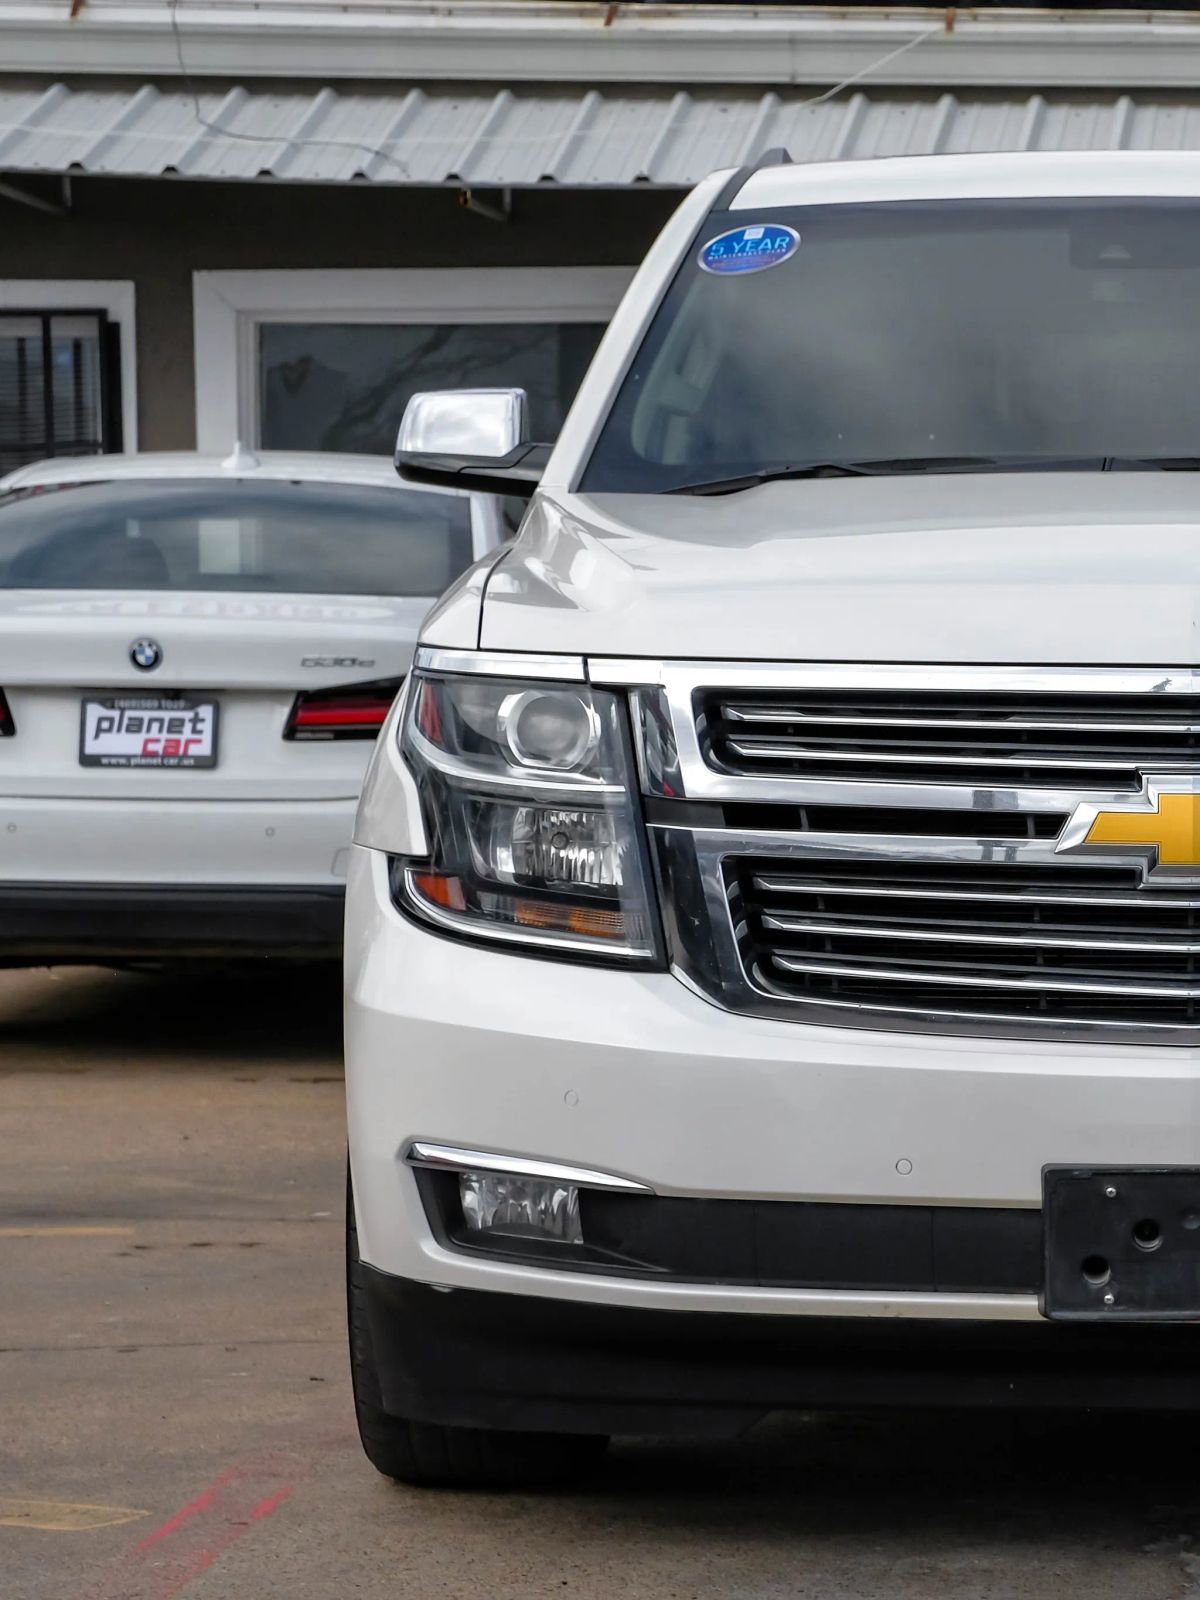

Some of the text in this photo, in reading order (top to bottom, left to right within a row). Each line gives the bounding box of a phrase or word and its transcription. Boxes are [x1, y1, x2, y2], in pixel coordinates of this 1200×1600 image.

[733, 237, 790, 253] YEAR
[94, 708, 206, 739] planet
[142, 738, 203, 757] car
